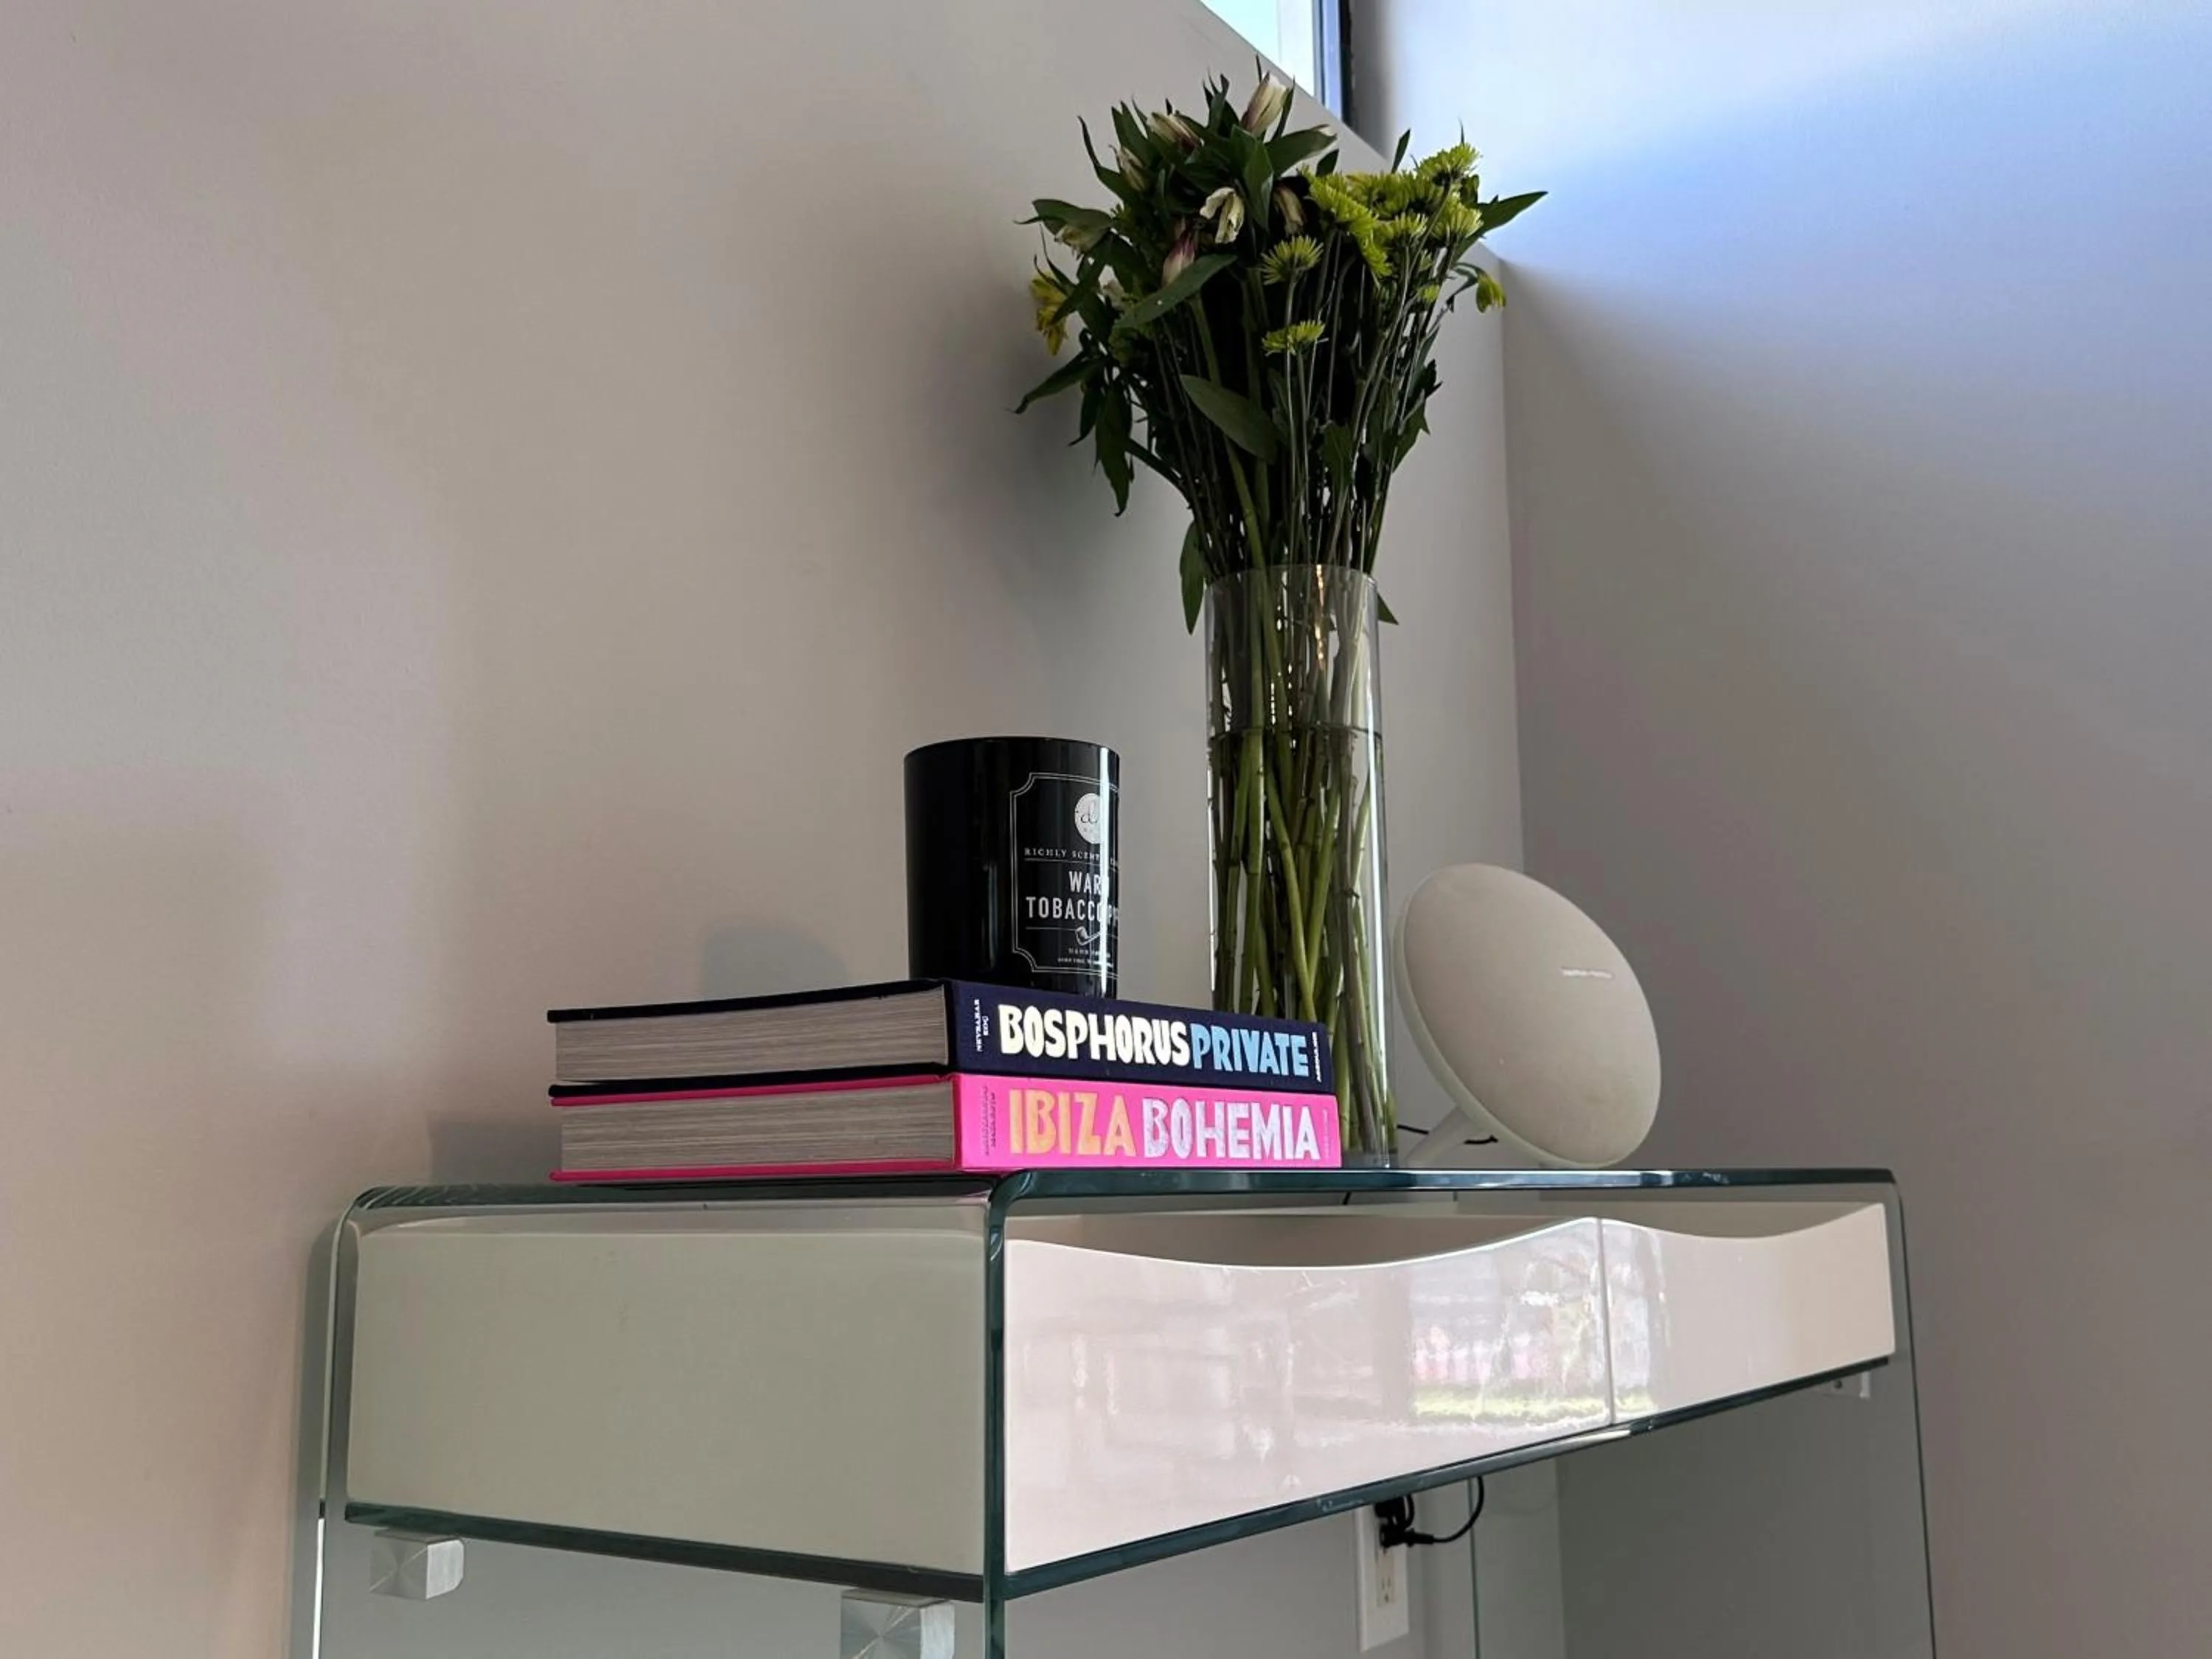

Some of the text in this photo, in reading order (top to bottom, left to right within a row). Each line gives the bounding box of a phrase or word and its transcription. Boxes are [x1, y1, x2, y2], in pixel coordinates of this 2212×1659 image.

[1023, 847, 1067, 858] RICHLY
[1071, 849, 1108, 861] SCENT
[1068, 870, 1109, 895] WAR
[998, 1004, 1310, 1077] BOSPHORUS PRIVATE
[1008, 1088, 1137, 1157] IBIZA
[1141, 1096, 1322, 1160] BOHEMIA
